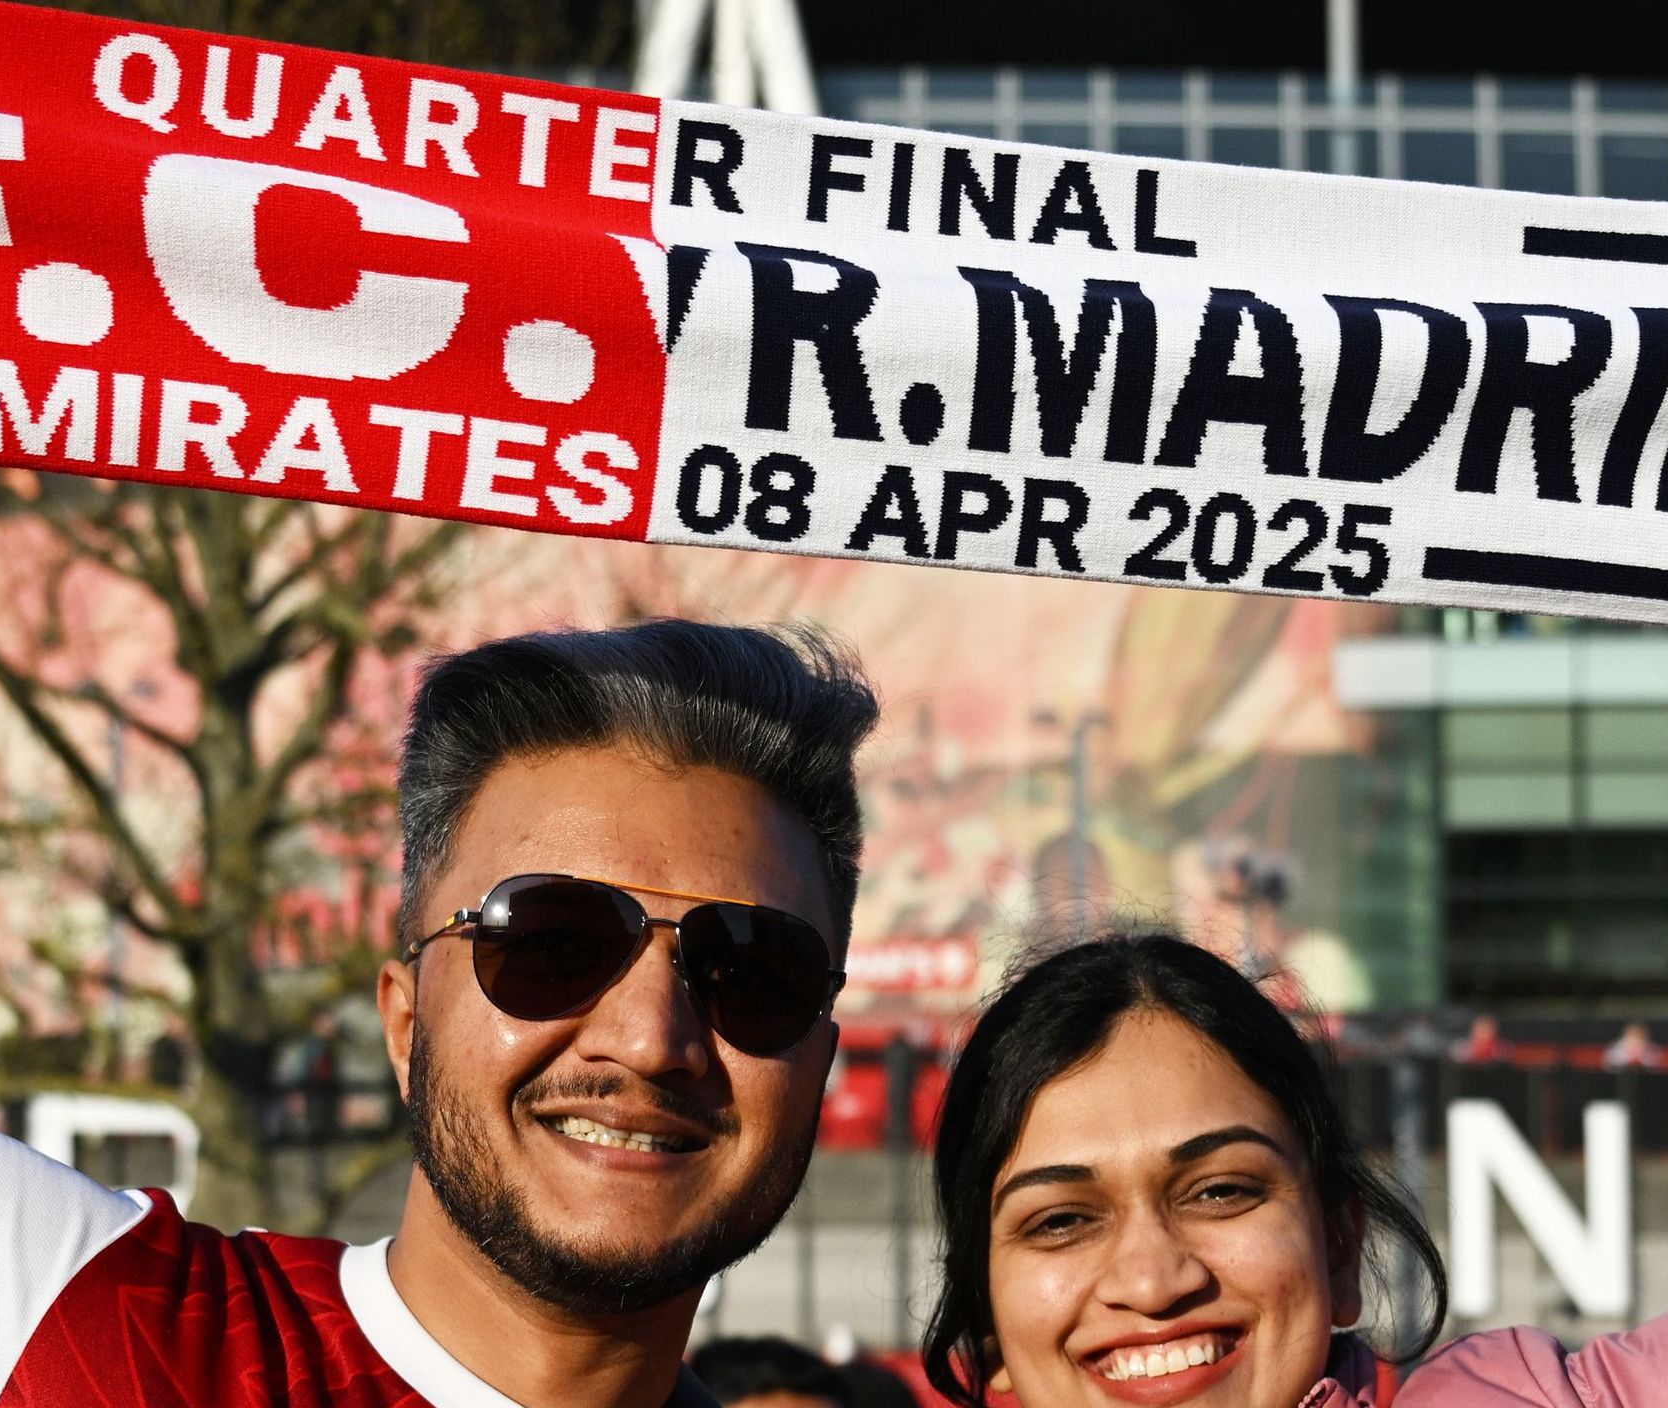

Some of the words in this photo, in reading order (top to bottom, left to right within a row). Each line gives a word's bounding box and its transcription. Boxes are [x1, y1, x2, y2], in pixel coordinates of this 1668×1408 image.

[92, 33, 745, 214] QUARTER
[806, 134, 1198, 259] FINAL
[677, 443, 817, 544] 08
[845, 465, 1091, 574] APR
[1128, 486, 1392, 597] 2025
